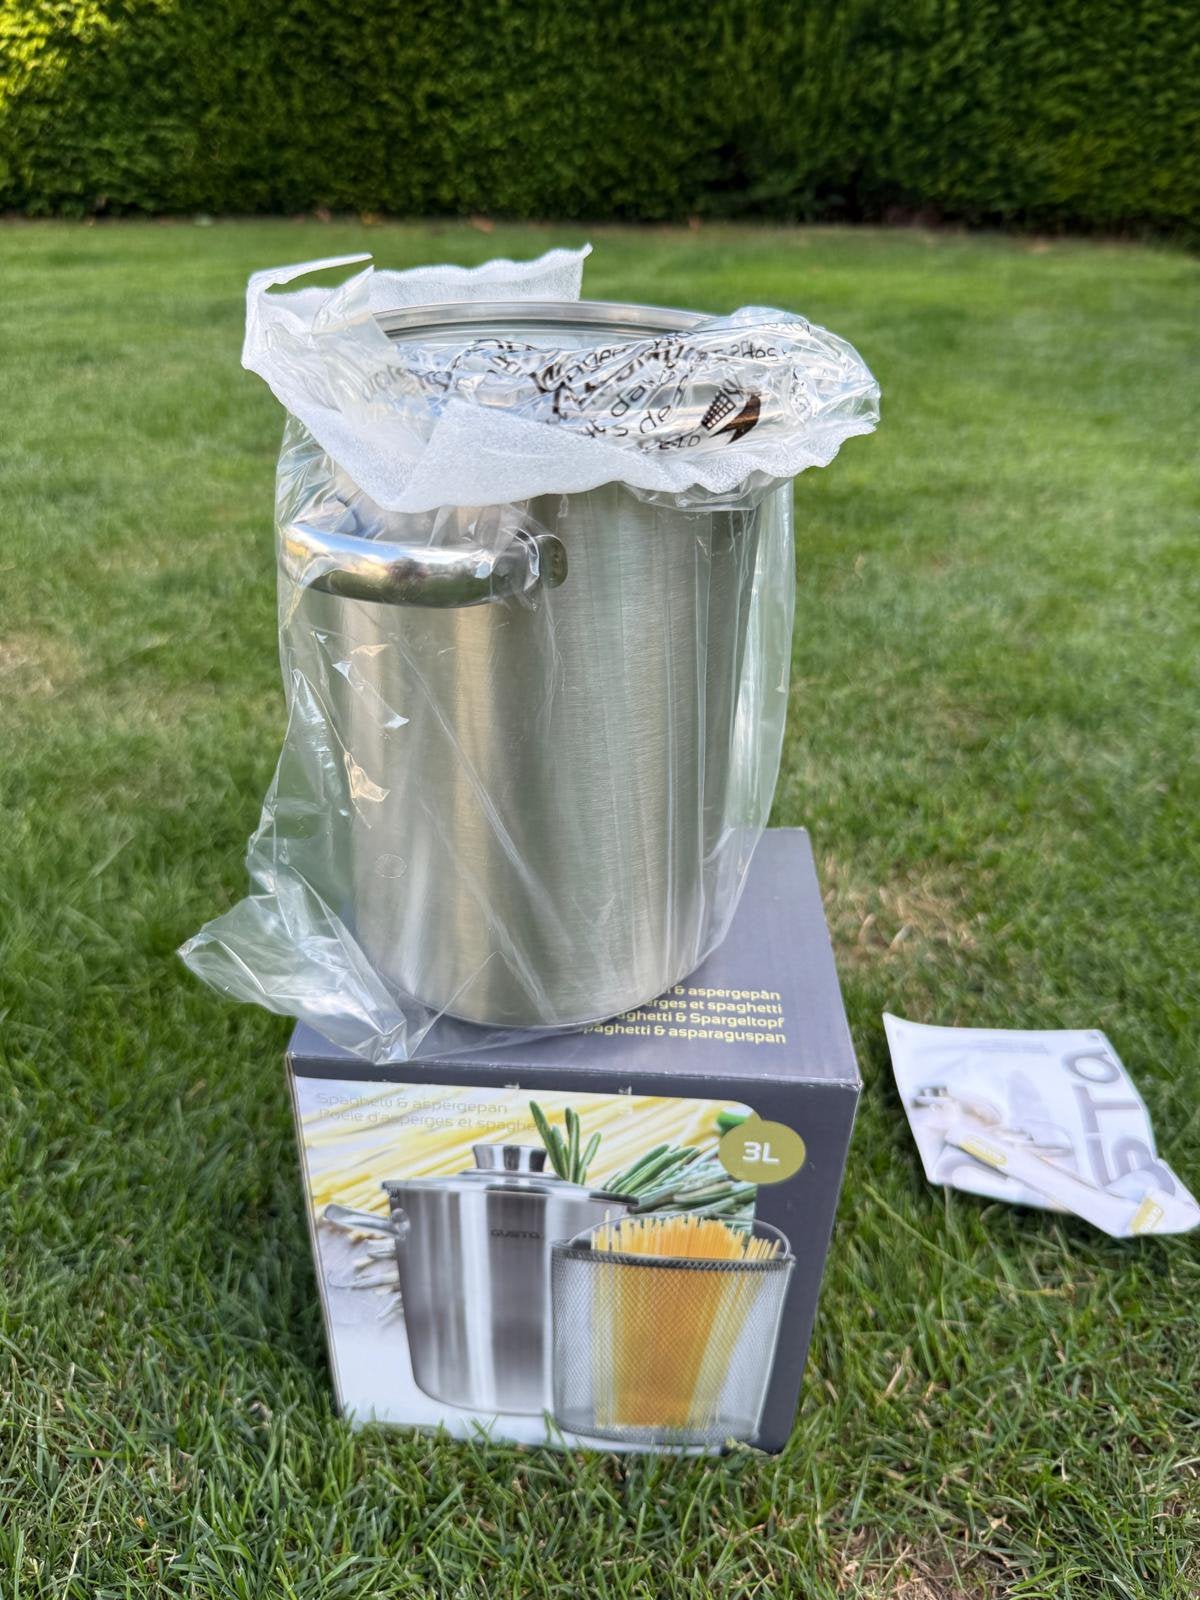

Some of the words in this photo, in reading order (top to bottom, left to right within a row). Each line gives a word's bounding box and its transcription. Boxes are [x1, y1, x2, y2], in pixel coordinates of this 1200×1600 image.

[674, 985, 685, 996] &
[690, 1001, 705, 1010] et
[707, 1001, 783, 1015] spaghetti
[616, 1010, 672, 1023] aghetti
[676, 1012, 687, 1023] &
[690, 1012, 785, 1029] Spargeltopf
[583, 1023, 651, 1036] paghetti
[654, 1025, 666, 1036] &
[668, 1028, 787, 1045] asparaguspan
[742, 1141, 780, 1165] 3L
